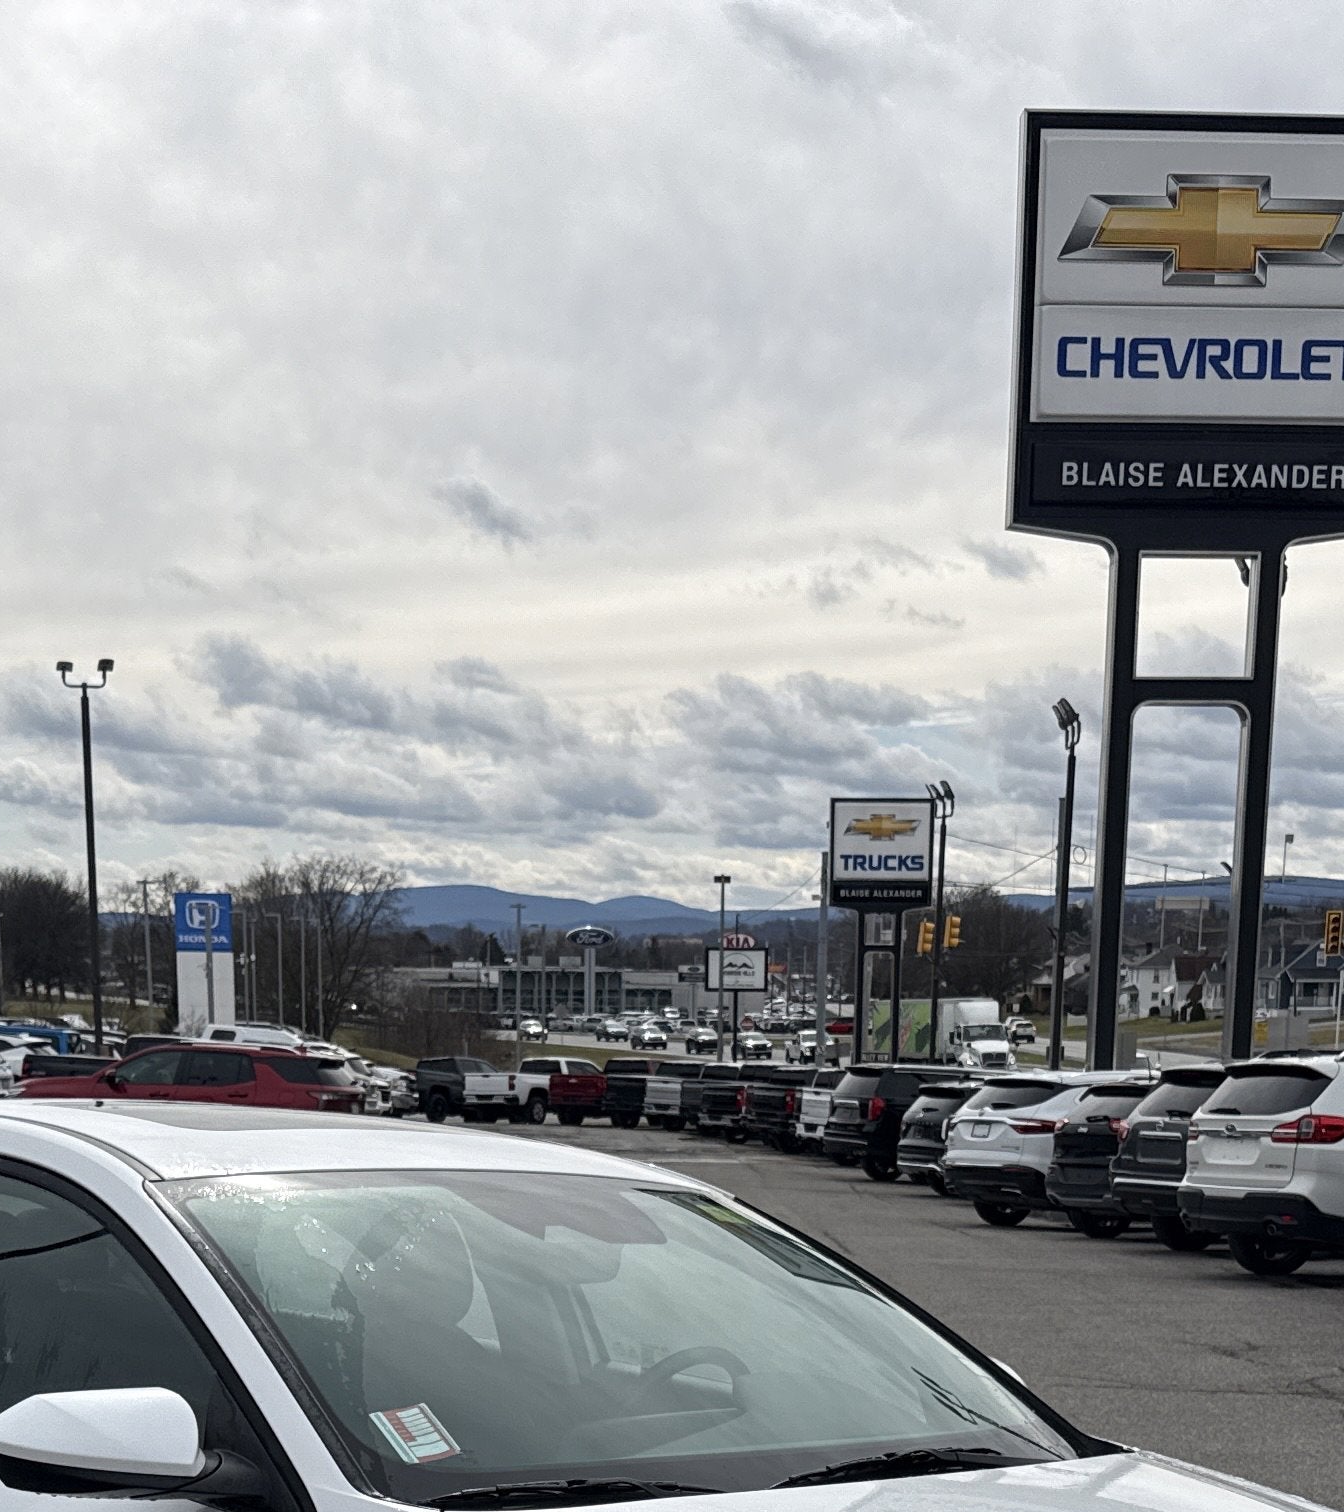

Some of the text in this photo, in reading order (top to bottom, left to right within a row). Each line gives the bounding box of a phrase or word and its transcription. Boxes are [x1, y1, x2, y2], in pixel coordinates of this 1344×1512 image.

[1061, 461, 1165, 488] BLAISE
[840, 854, 924, 872] TRUCKS
[840, 889, 923, 898] BLAISE ALEXANDER
[576, 931, 605, 945] Ford
[726, 936, 751, 949] KIA
